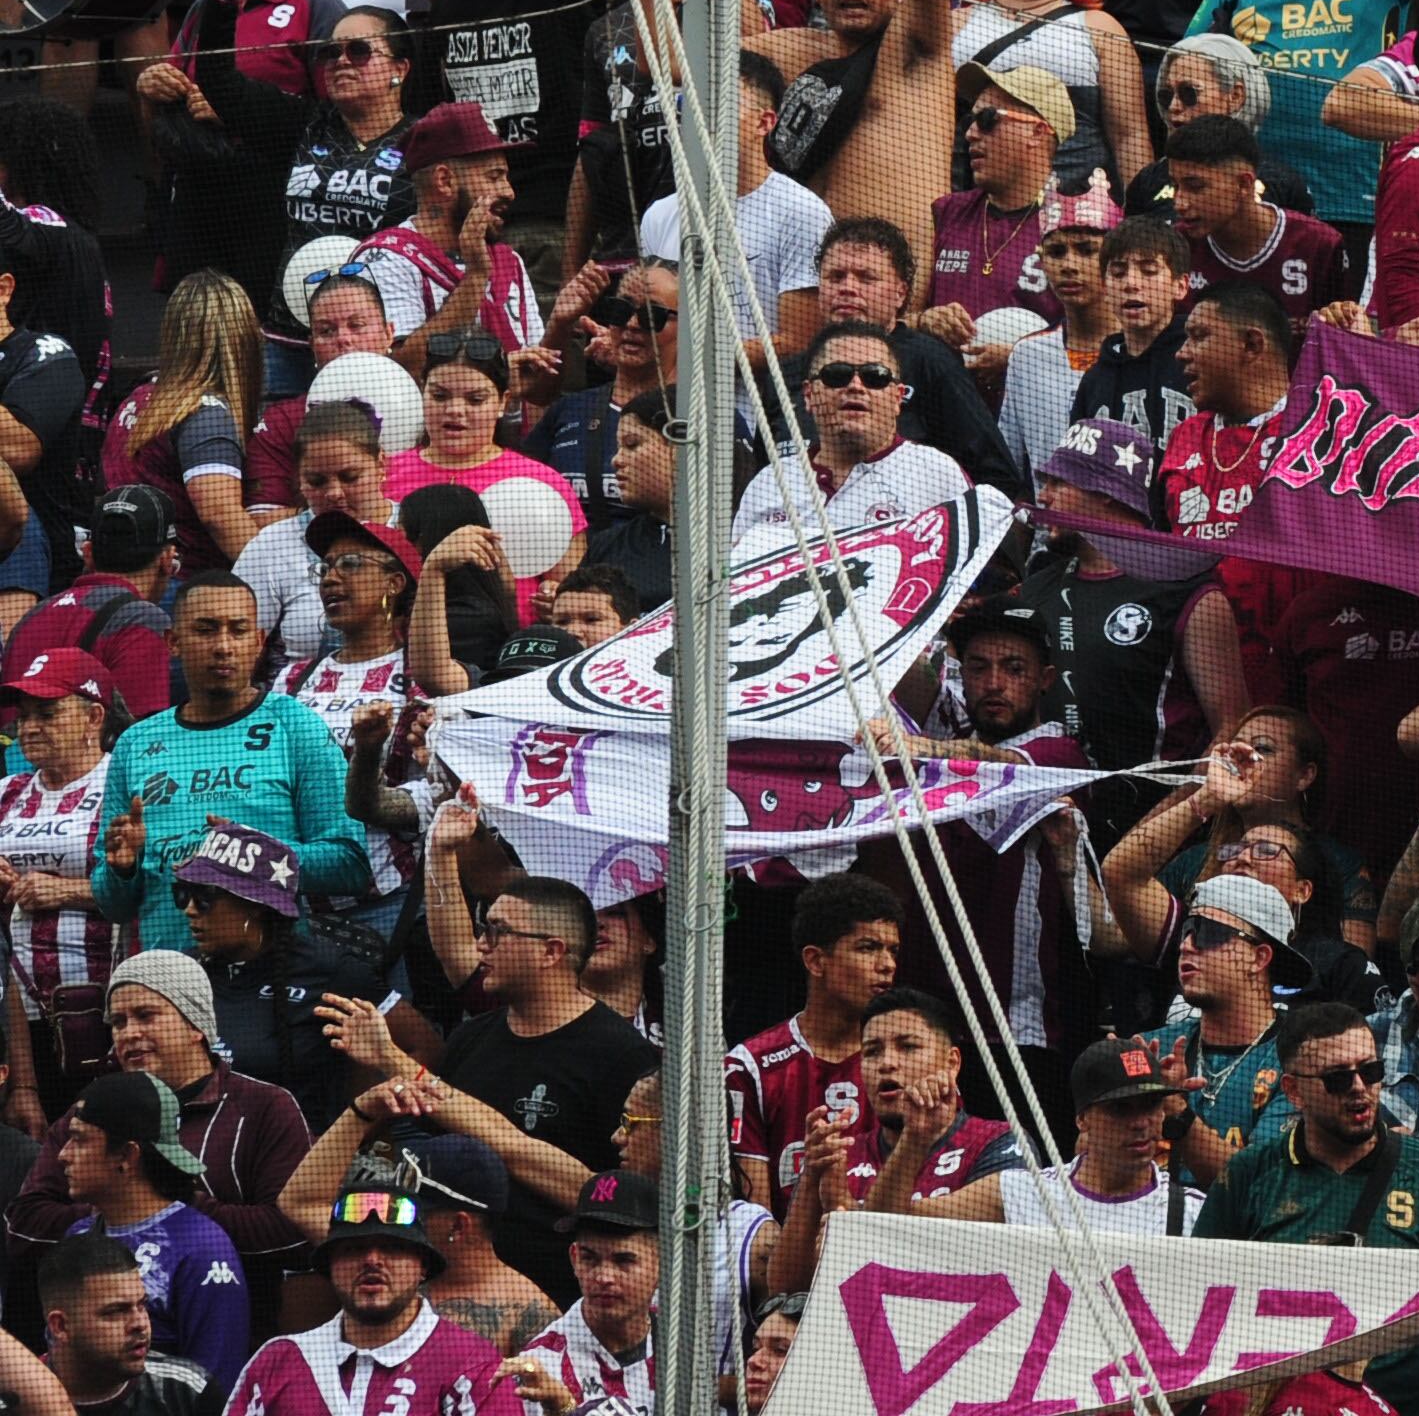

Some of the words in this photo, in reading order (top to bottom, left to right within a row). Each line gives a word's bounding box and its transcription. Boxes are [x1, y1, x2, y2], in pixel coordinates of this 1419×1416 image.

[267, 3, 295, 29] S
[1282, 22, 1353, 40] CREDOMATIC
[327, 171, 393, 204] BAC
[286, 200, 384, 229] LIBERTY
[1059, 616, 1076, 652] NIKE
[245, 723, 273, 752] S
[188, 763, 253, 791] BAC
[18, 819, 73, 838] BAC
[1386, 1191, 1416, 1228] S
